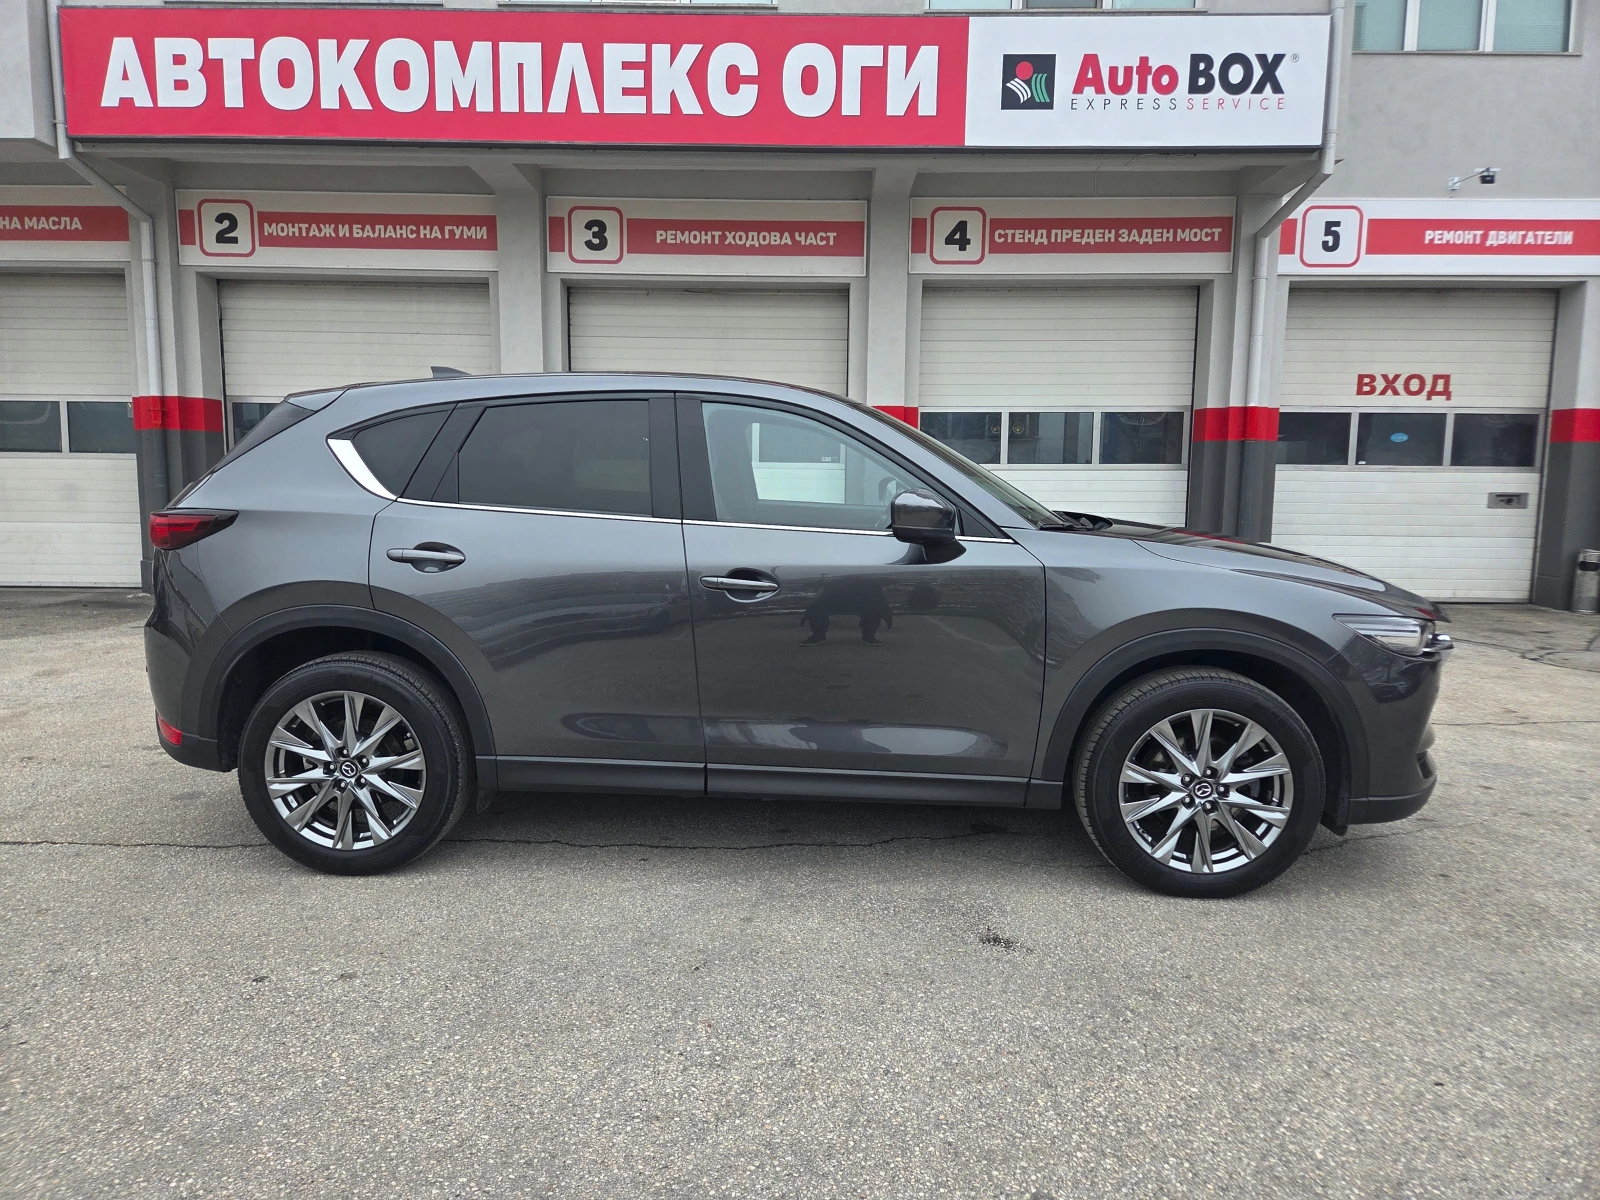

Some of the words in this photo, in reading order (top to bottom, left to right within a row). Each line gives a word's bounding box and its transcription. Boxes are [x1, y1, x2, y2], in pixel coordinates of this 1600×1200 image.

[100, 37, 759, 117] АВТОКОМПЛЕКС
[782, 43, 939, 117] ОГИ
[1072, 53, 1179, 95] Auto
[1188, 52, 1286, 96] BOX
[0, 216, 22, 230] НА
[24, 216, 83, 230] МАСЛА
[214, 212, 239, 244] 2
[263, 222, 336, 238] МОНТАЖ
[338, 224, 350, 237] И
[352, 224, 417, 239] БАЛАНС
[420, 225, 443, 240] НА
[444, 225, 488, 240] ГУМИ
[583, 219, 608, 252] 3
[944, 220, 971, 252] 4
[994, 228, 1047, 244] СТЕНД
[1050, 229, 1116, 244] ПРЕДЕН
[1118, 228, 1174, 244] ЗАДЕН
[1176, 227, 1223, 243] МОСТ
[1321, 220, 1341, 253] 5
[1424, 230, 1484, 245] РЕМОНТ
[1486, 230, 1573, 246] ДВИГАТЕЛИ
[656, 230, 722, 245] РЕМОНТ
[724, 231, 792, 248] ХОДОВА
[795, 231, 837, 246] ЧАСТ
[1355, 373, 1453, 401] ВХОД
